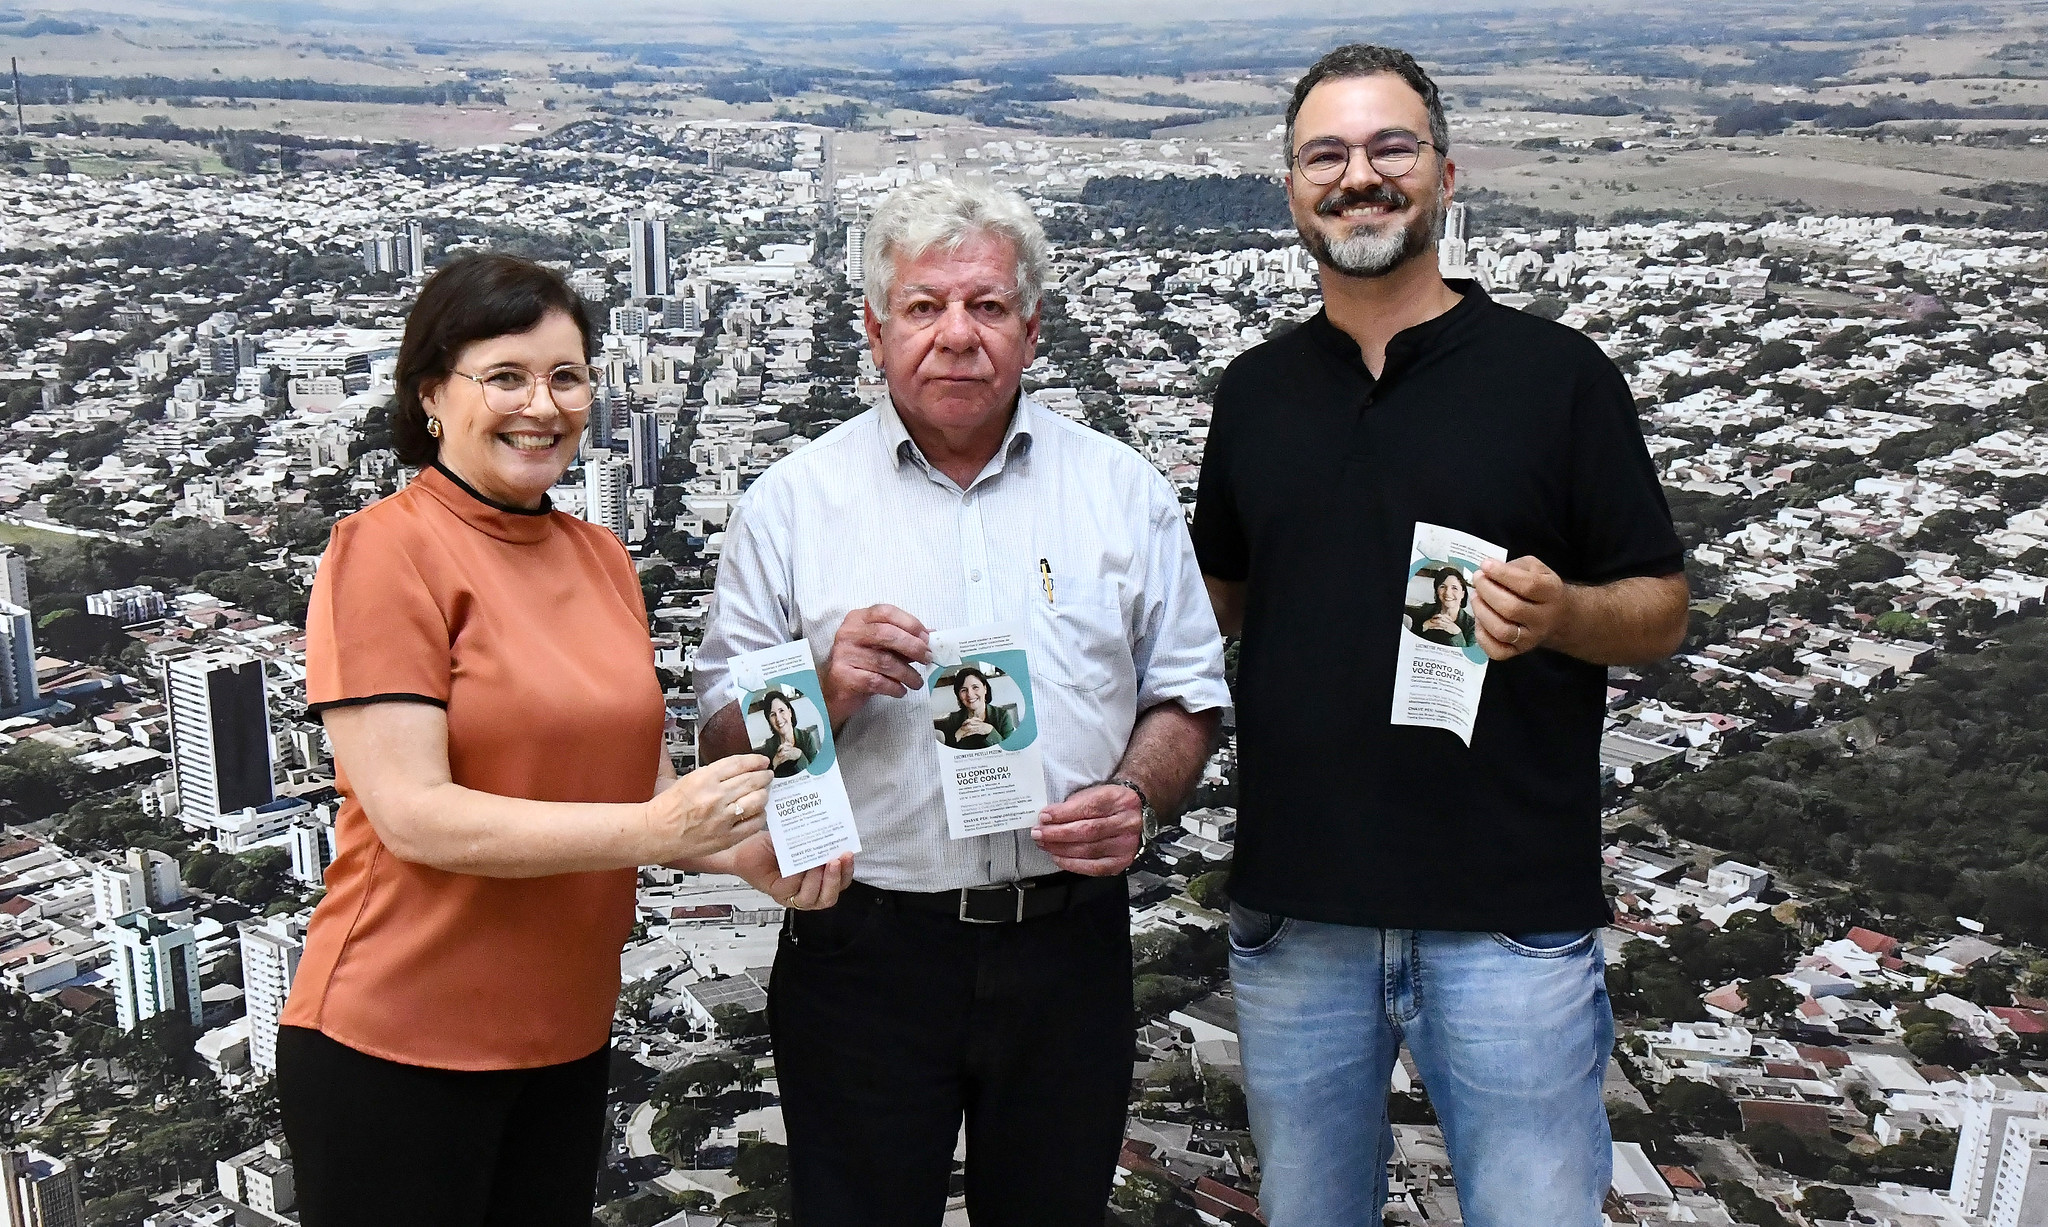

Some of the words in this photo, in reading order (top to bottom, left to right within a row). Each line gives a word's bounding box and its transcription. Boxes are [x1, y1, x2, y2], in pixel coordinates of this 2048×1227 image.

[1412, 667, 1433, 675] VOCÊ
[1436, 670, 1464, 683] CONTA?
[1425, 662, 1452, 672] CONTO
[1454, 668, 1464, 676] OU
[957, 777, 978, 786] VOCÊ
[980, 772, 1011, 782] CONTA?
[968, 768, 996, 778] CONTO
[778, 807, 796, 817] VOCÊ
[797, 799, 822, 812] CONTA?
[786, 796, 808, 807] CONTO
